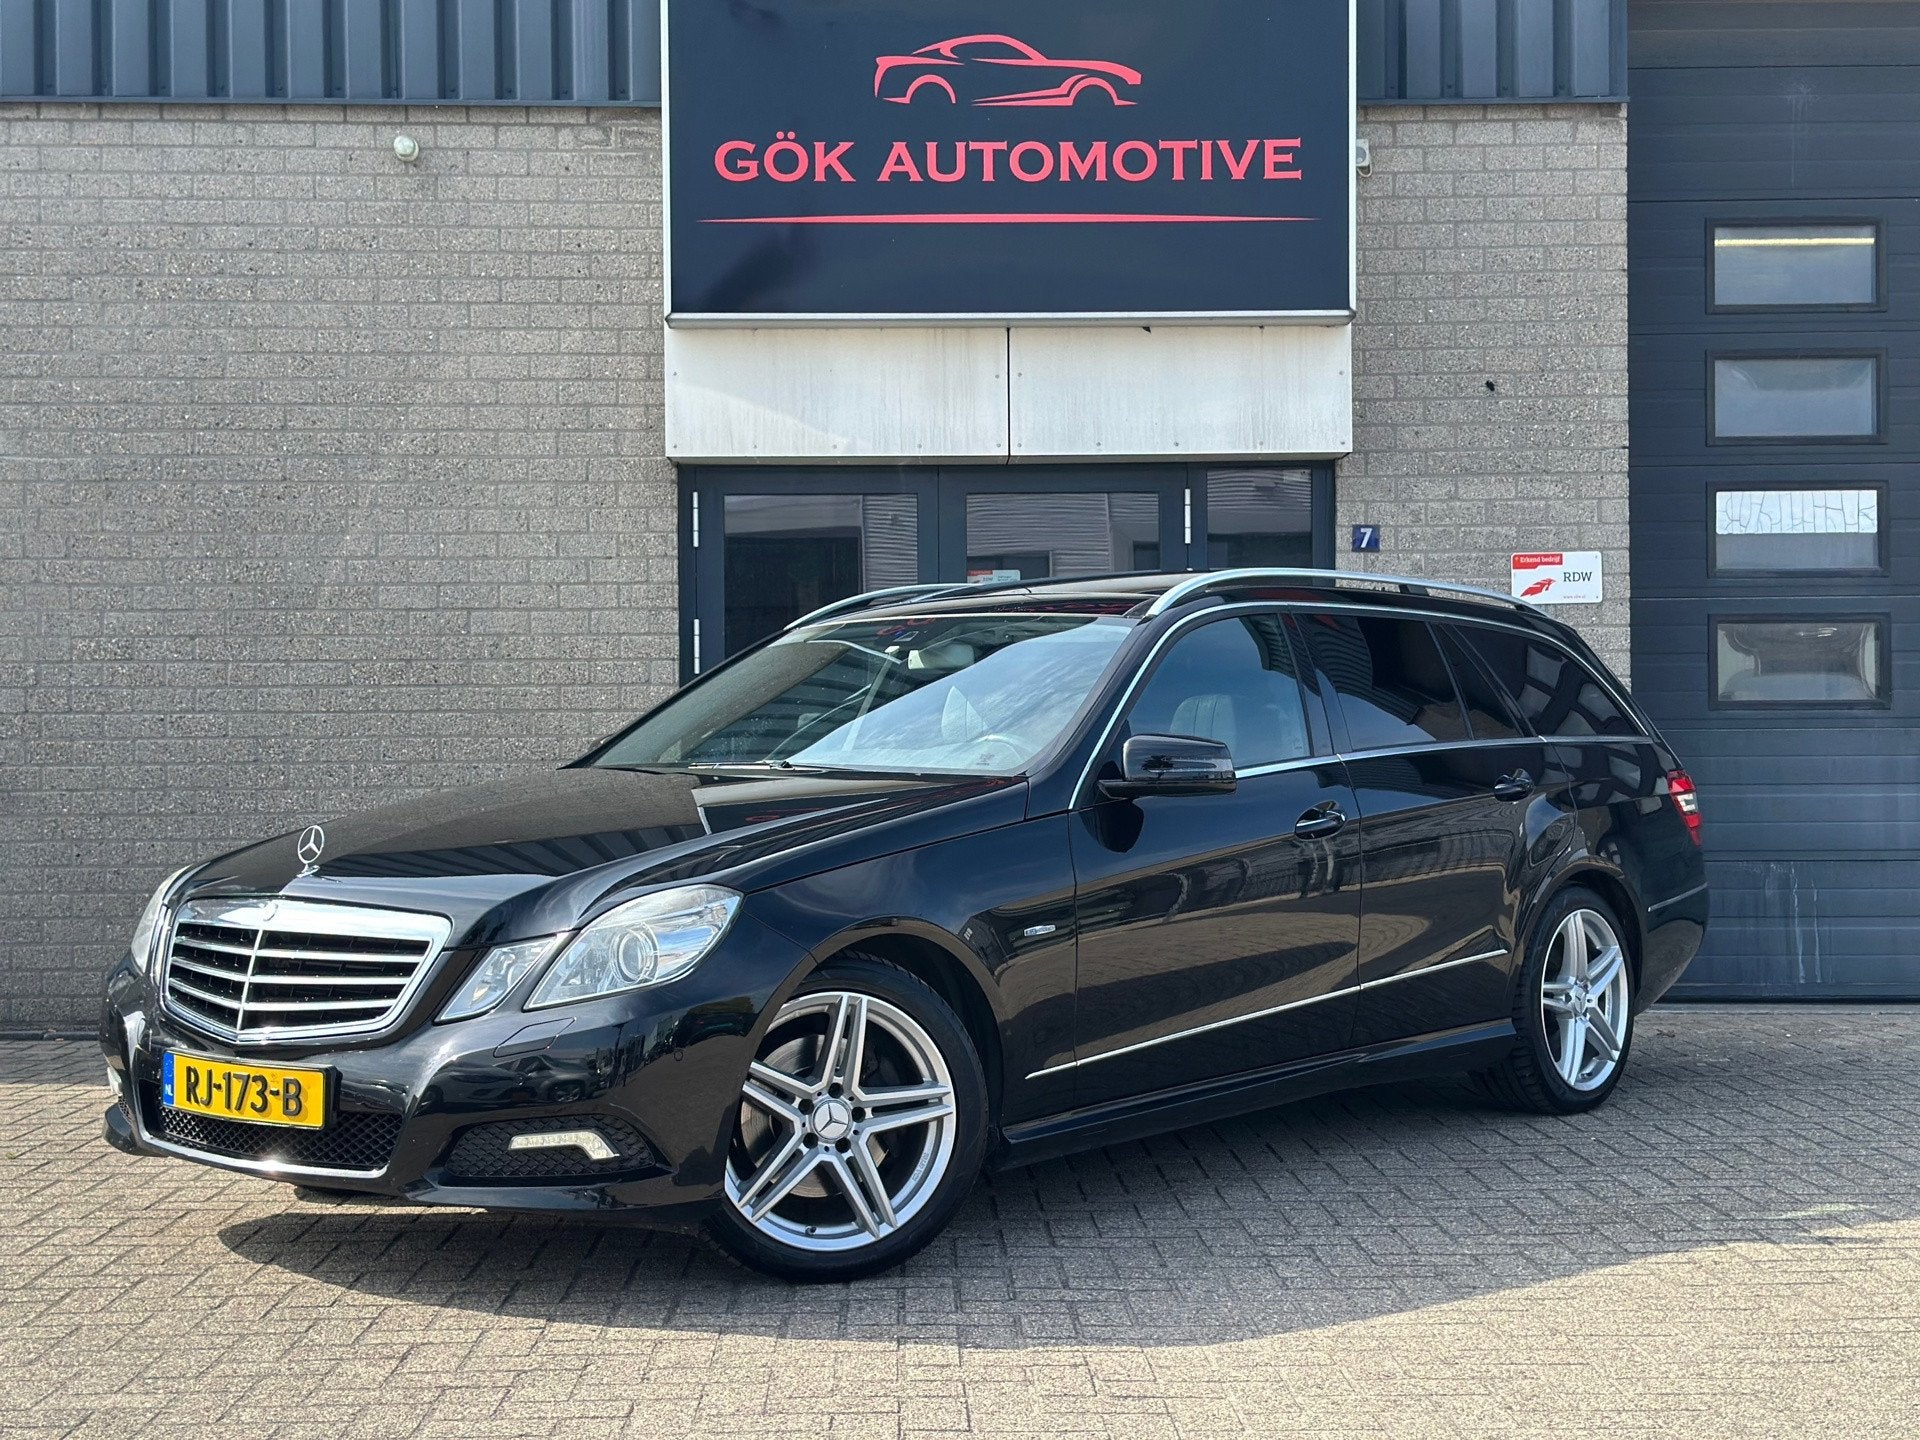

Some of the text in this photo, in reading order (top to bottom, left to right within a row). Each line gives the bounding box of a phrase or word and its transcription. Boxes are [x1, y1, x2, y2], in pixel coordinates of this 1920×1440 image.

[714, 131, 1302, 182] GÖK AUTOMOTIVE
[1360, 527, 1373, 548] 7
[1541, 555, 1560, 563] bedrijf
[1563, 571, 1592, 582] RDW
[164, 1084, 174, 1097] NL
[186, 1065, 303, 1117] RJ-173-B
